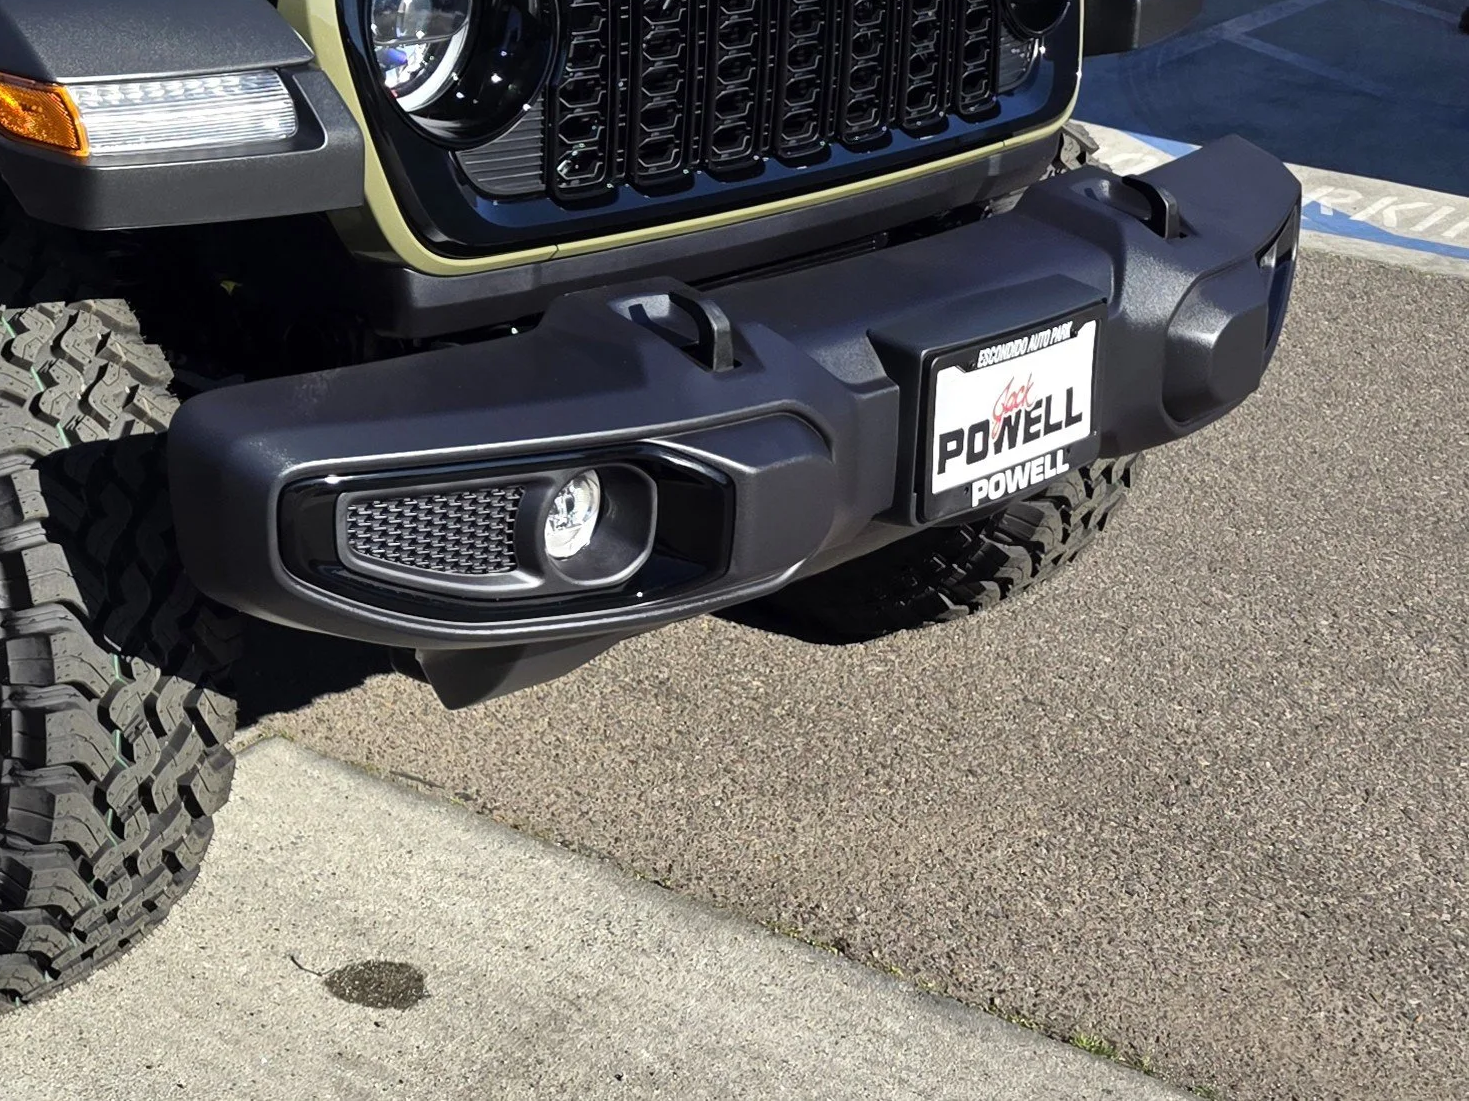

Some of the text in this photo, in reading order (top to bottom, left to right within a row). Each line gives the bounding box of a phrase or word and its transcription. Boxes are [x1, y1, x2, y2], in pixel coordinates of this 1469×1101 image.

[977, 321, 1074, 368] ESCONDIDO AUTO PARK
[937, 386, 1083, 476] POWELL
[992, 372, 1035, 440] Jack
[971, 448, 1070, 508] POWELL
